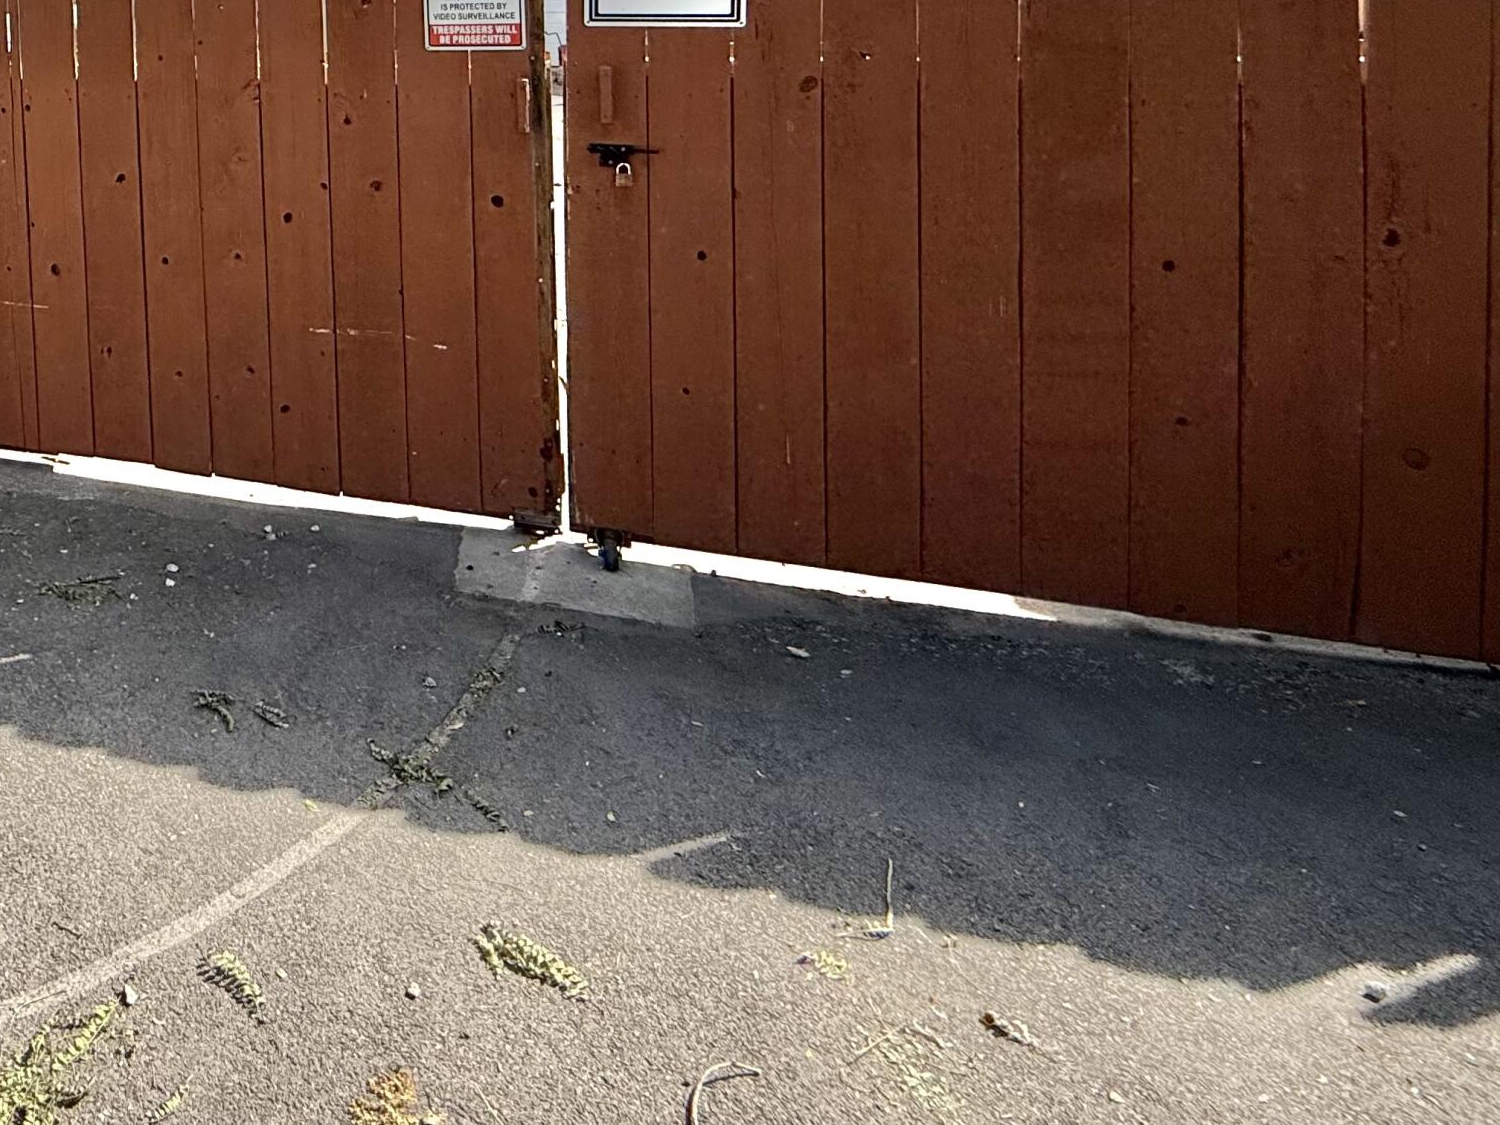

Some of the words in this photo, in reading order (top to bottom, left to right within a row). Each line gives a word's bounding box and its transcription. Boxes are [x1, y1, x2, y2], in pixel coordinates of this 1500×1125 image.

[440, 3, 448, 11] IS
[449, 2, 495, 11] PROTECTED
[496, 2, 507, 10] BY
[433, 12, 457, 21] VIDEO
[457, 11, 516, 20] SURVEILLANCE
[432, 25, 494, 35] TRESPASSERS
[494, 24, 518, 34] WILL
[439, 34, 451, 44] BE
[452, 34, 512, 44] PROSECUTED
